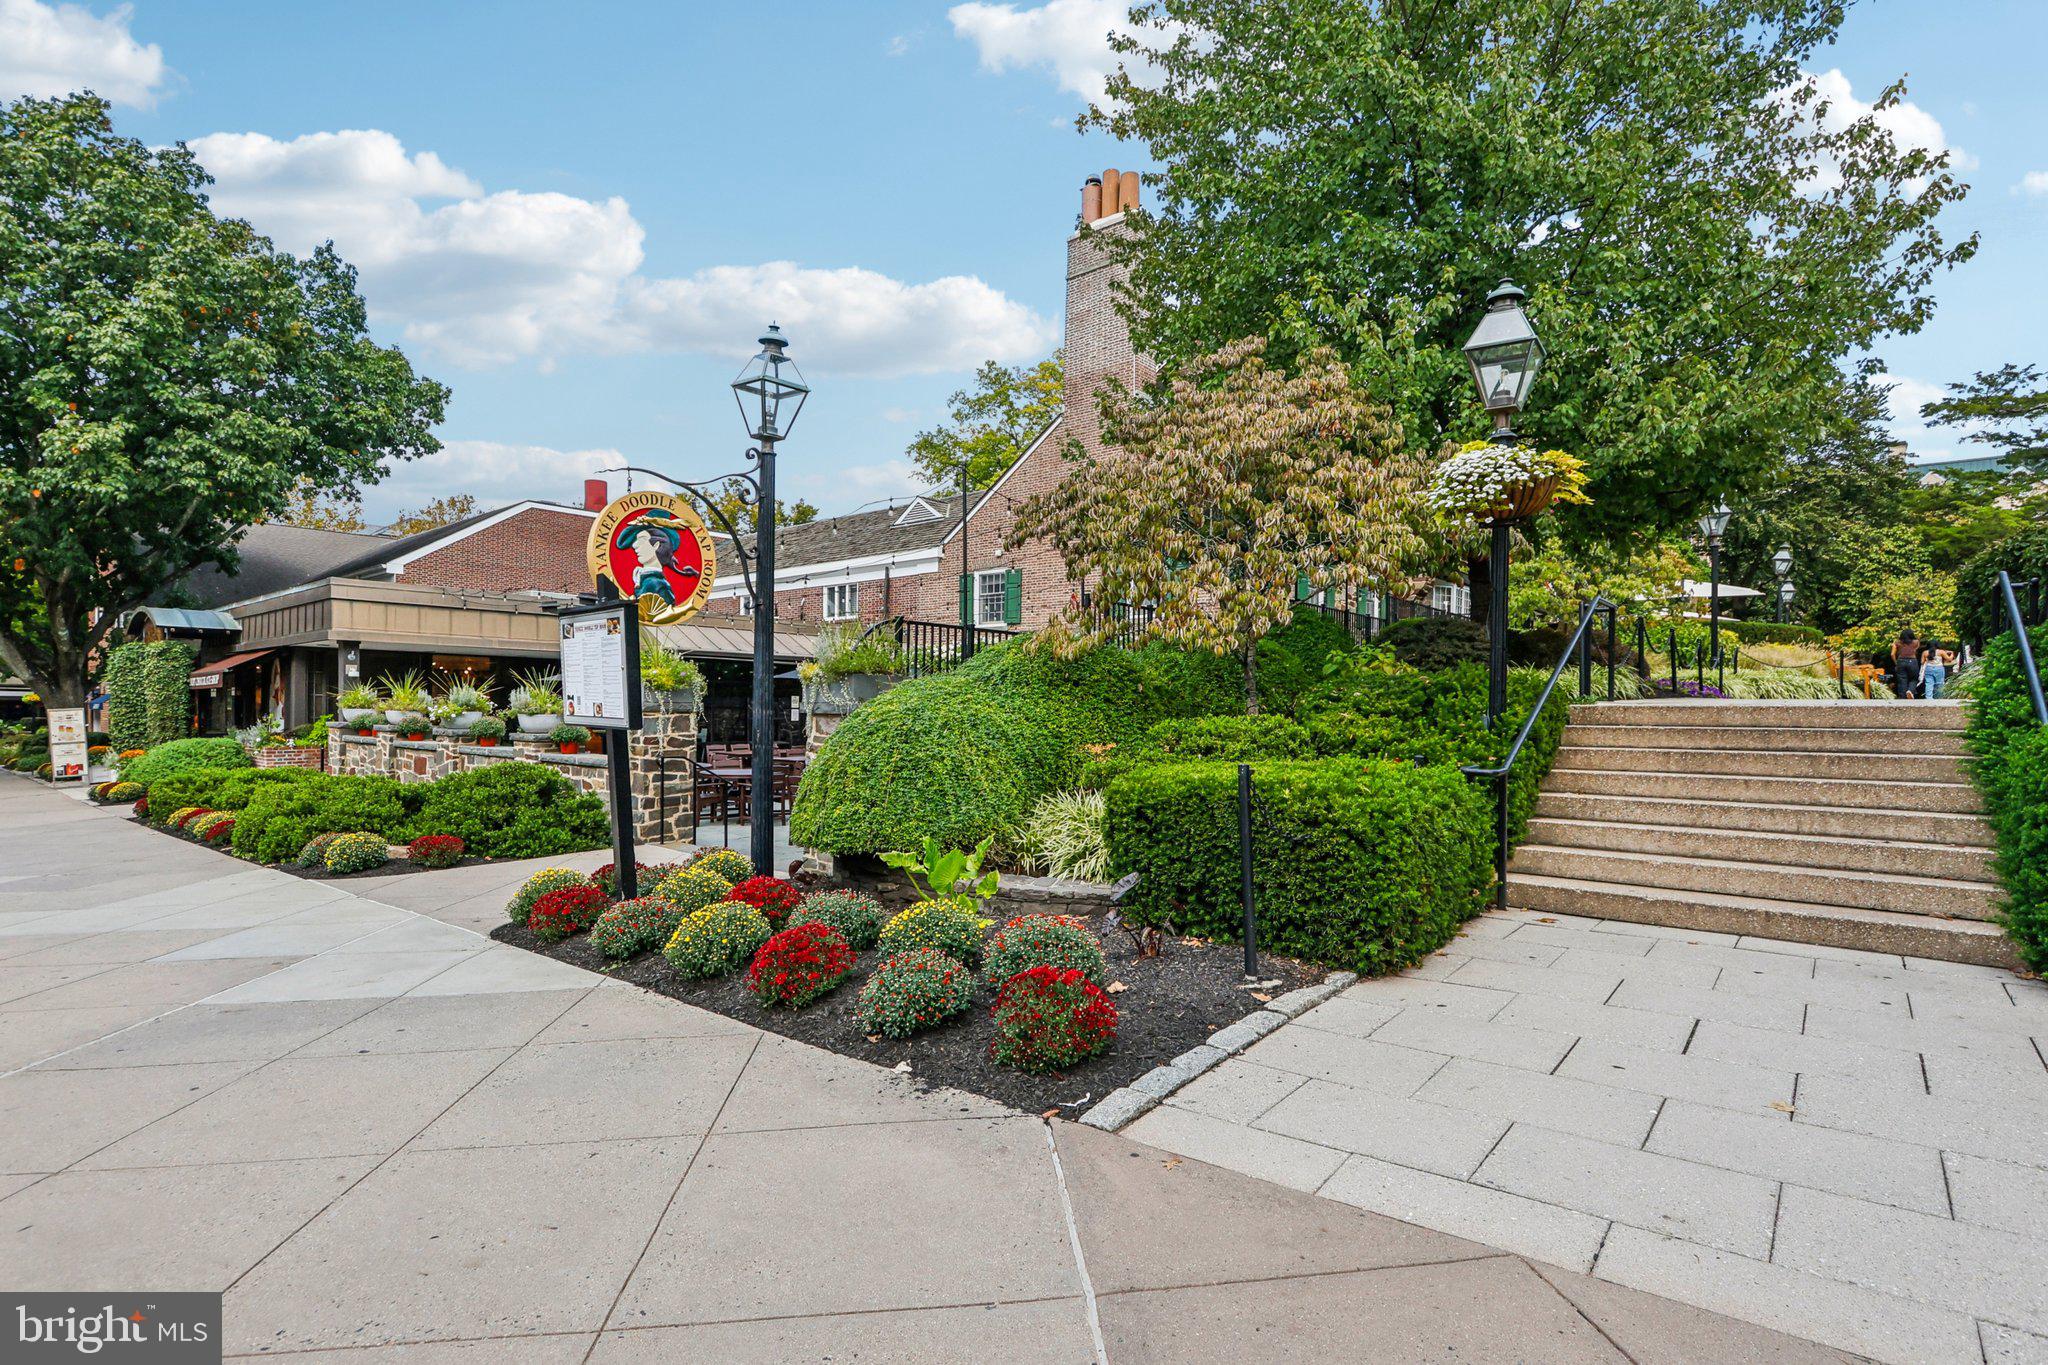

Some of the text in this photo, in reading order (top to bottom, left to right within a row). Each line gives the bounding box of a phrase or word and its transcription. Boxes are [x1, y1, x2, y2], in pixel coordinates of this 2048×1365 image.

[595, 493, 713, 600] YANKEE DOODLE TAP ROOM
